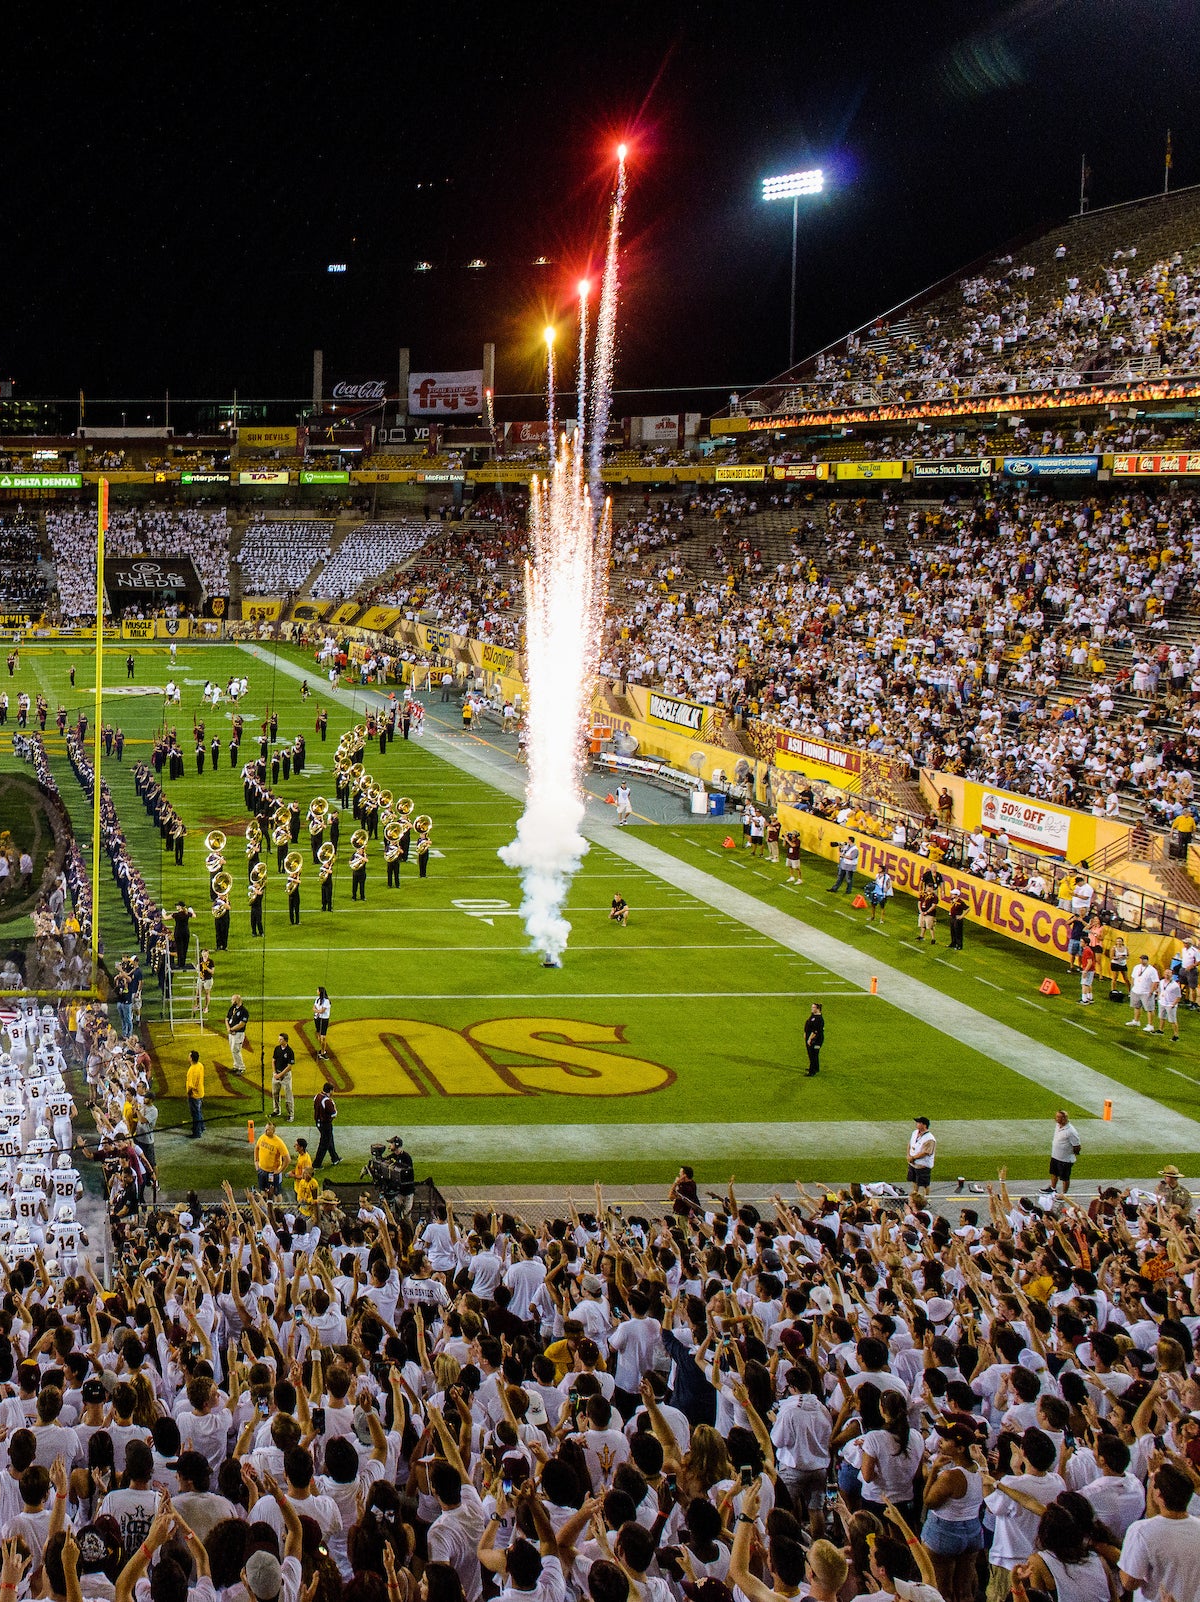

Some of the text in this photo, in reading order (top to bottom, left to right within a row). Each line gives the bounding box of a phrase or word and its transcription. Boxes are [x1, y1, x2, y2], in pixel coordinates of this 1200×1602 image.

[332, 380, 386, 398] Coca-Cola
[412, 379, 479, 410] fry's
[247, 432, 291, 442] SUN DEVILS
[414, 427, 430, 440] yp
[915, 463, 980, 475] TALKING STICK RESORT
[1013, 462, 1032, 473] Ford
[14, 478, 78, 486] DELTA DENTAL
[184, 473, 230, 483] enterprise
[118, 580, 186, 588] NEEDLE
[249, 607, 275, 616] ASU
[125, 622, 152, 630] MUSCLE
[130, 629, 148, 638] MILK
[426, 628, 451, 648] GEICO
[651, 695, 700, 730] MUSCLE MILK
[787, 737, 802, 751] ASU
[802, 740, 827, 759] HONOR
[828, 750, 848, 767] ROW
[1001, 802, 1022, 819] 50%
[1023, 808, 1046, 824] OFF
[43, 1024, 50, 1034] 5
[46, 1055, 54, 1067] 3
[3, 1076, 11, 1087] 4
[31, 1086, 39, 1098] 6
[51, 1104, 68, 1116] 26
[20, 1203, 36, 1217] 91
[58, 1235, 75, 1251] 14
